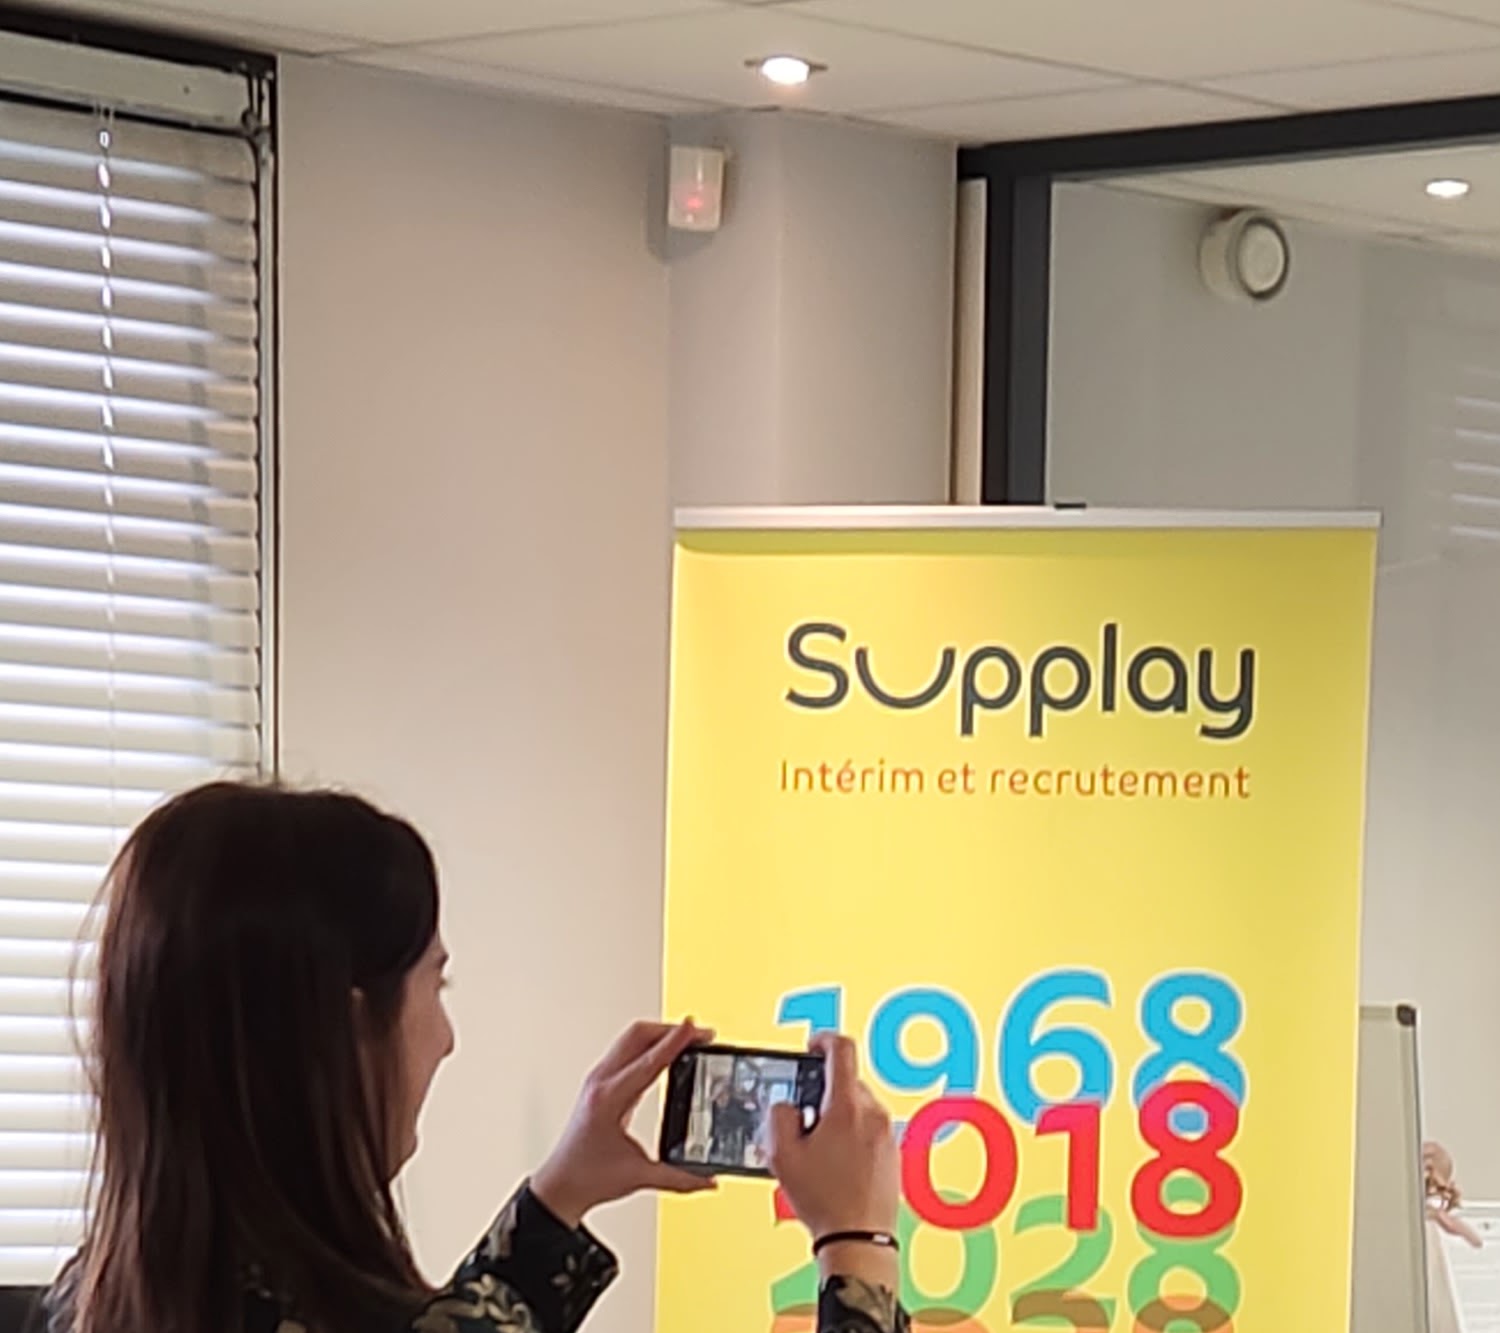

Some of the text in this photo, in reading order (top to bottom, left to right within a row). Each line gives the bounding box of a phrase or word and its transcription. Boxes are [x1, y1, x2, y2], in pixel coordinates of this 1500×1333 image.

[786, 622, 1256, 739] Supplay
[780, 758, 1251, 799] Intérim et recrutement
[773, 1081, 1242, 1238] 018
